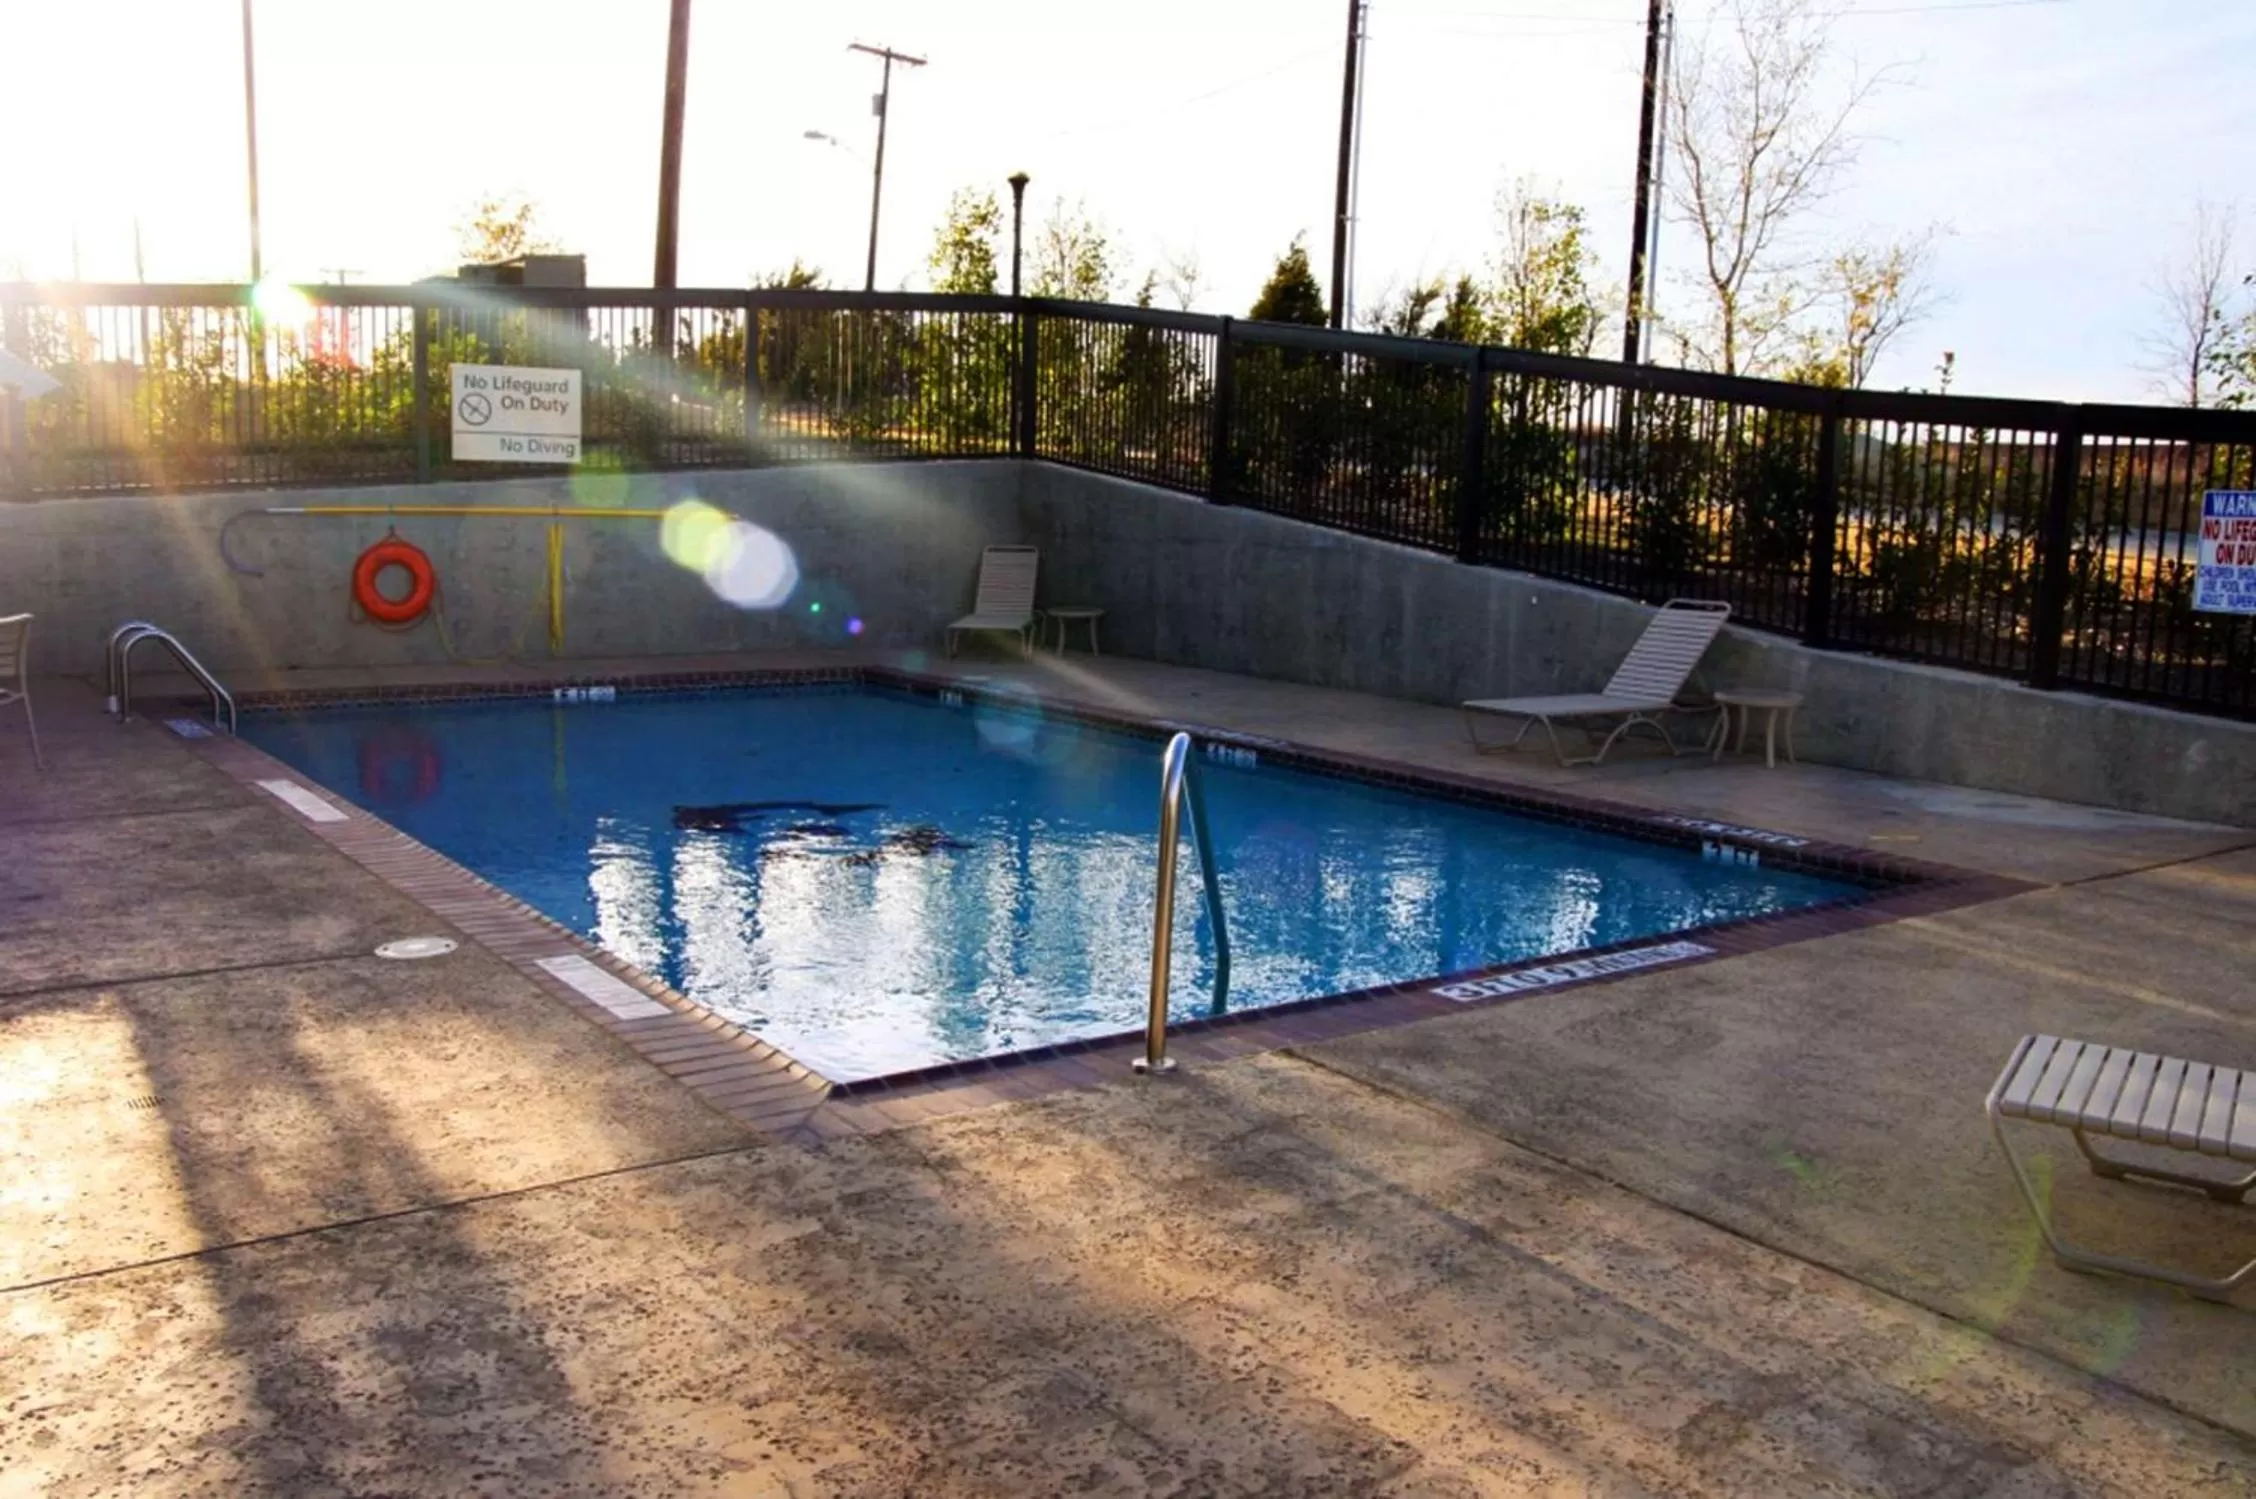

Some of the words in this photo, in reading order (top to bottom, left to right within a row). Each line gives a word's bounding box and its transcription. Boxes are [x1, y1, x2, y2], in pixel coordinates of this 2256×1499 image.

[464, 374, 488, 390] No
[493, 375, 569, 396] Lifeguard
[501, 396, 525, 411] On
[530, 397, 569, 416] Duty
[500, 437, 524, 453] No
[528, 439, 576, 458] Diving
[2202, 519, 2220, 540] NO
[2216, 543, 2233, 565] ON
[2237, 544, 2256, 566] DU
